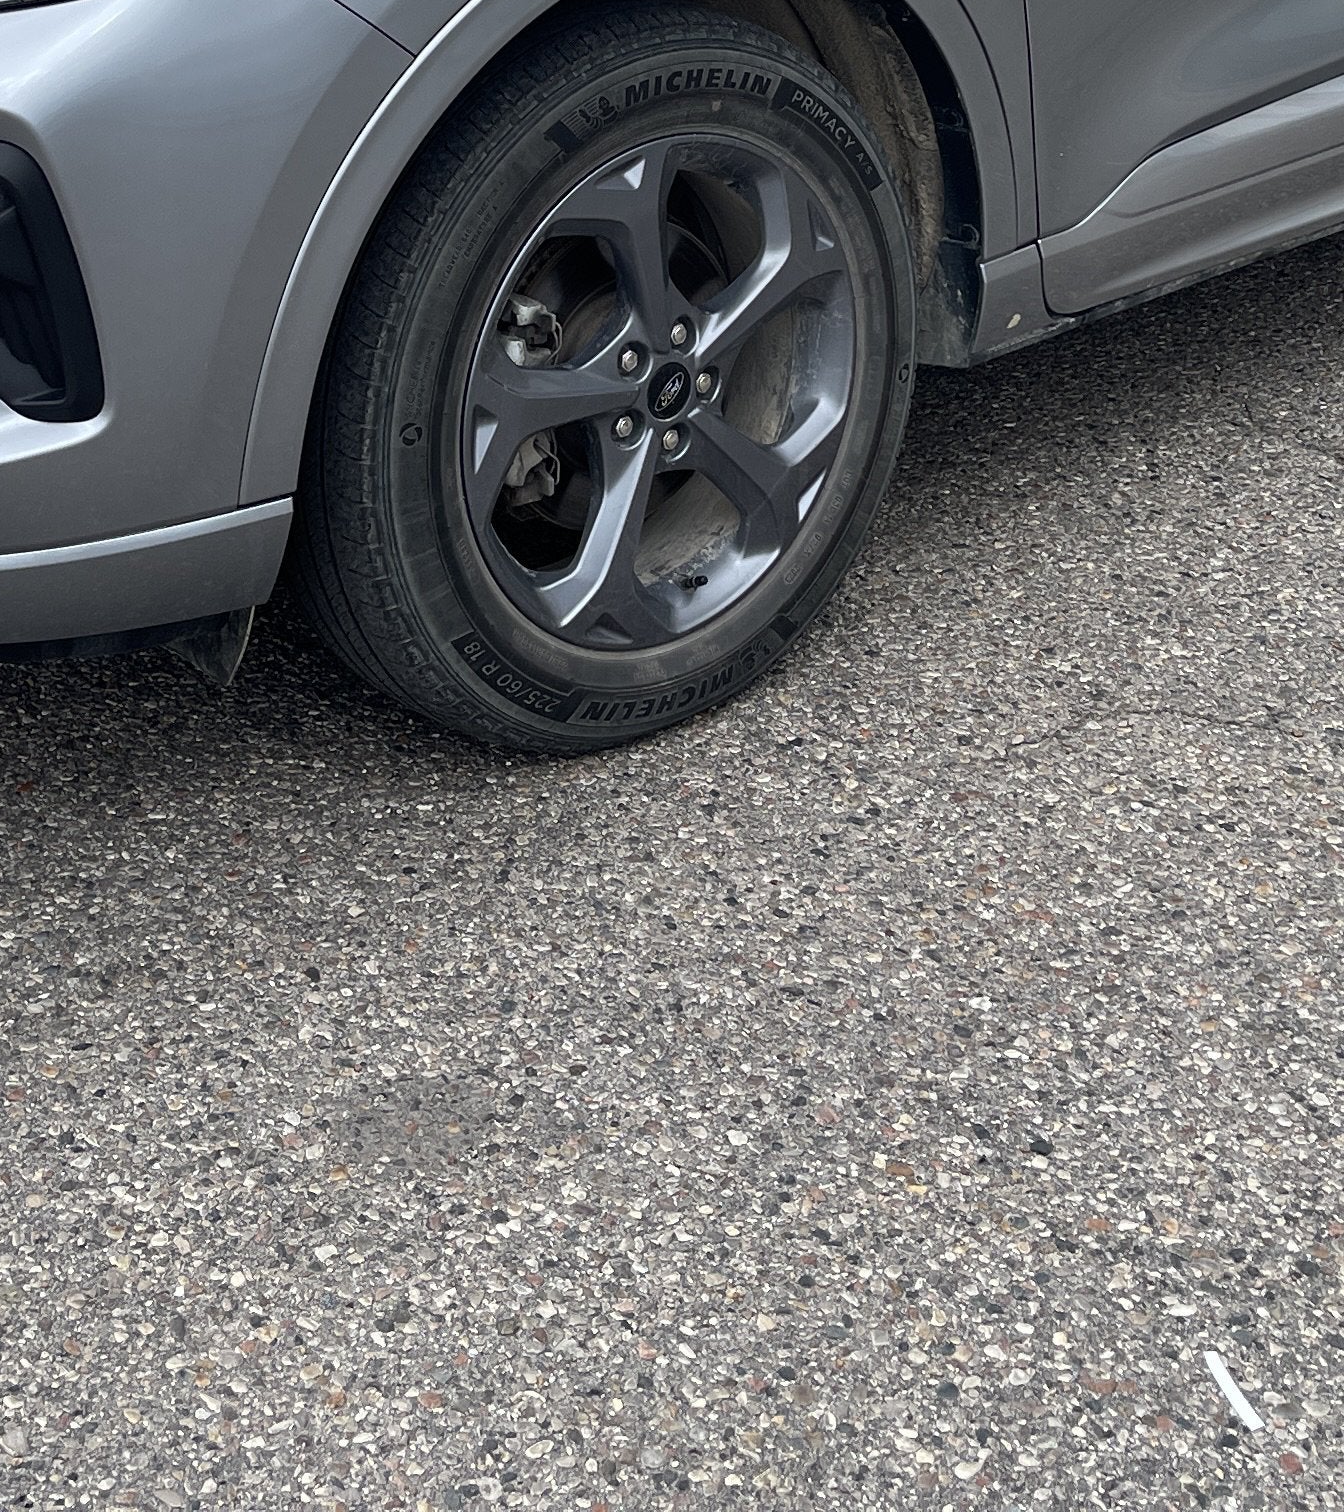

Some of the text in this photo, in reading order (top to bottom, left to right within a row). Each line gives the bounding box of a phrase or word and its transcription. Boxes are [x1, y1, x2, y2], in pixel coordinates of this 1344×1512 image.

[624, 67, 873, 176] MICHELIN PRIMACY A/S
[462, 639, 486, 662] 18
[479, 659, 496, 677] R
[495, 674, 564, 714] 225/60
[580, 669, 734, 721] MICHELIN
